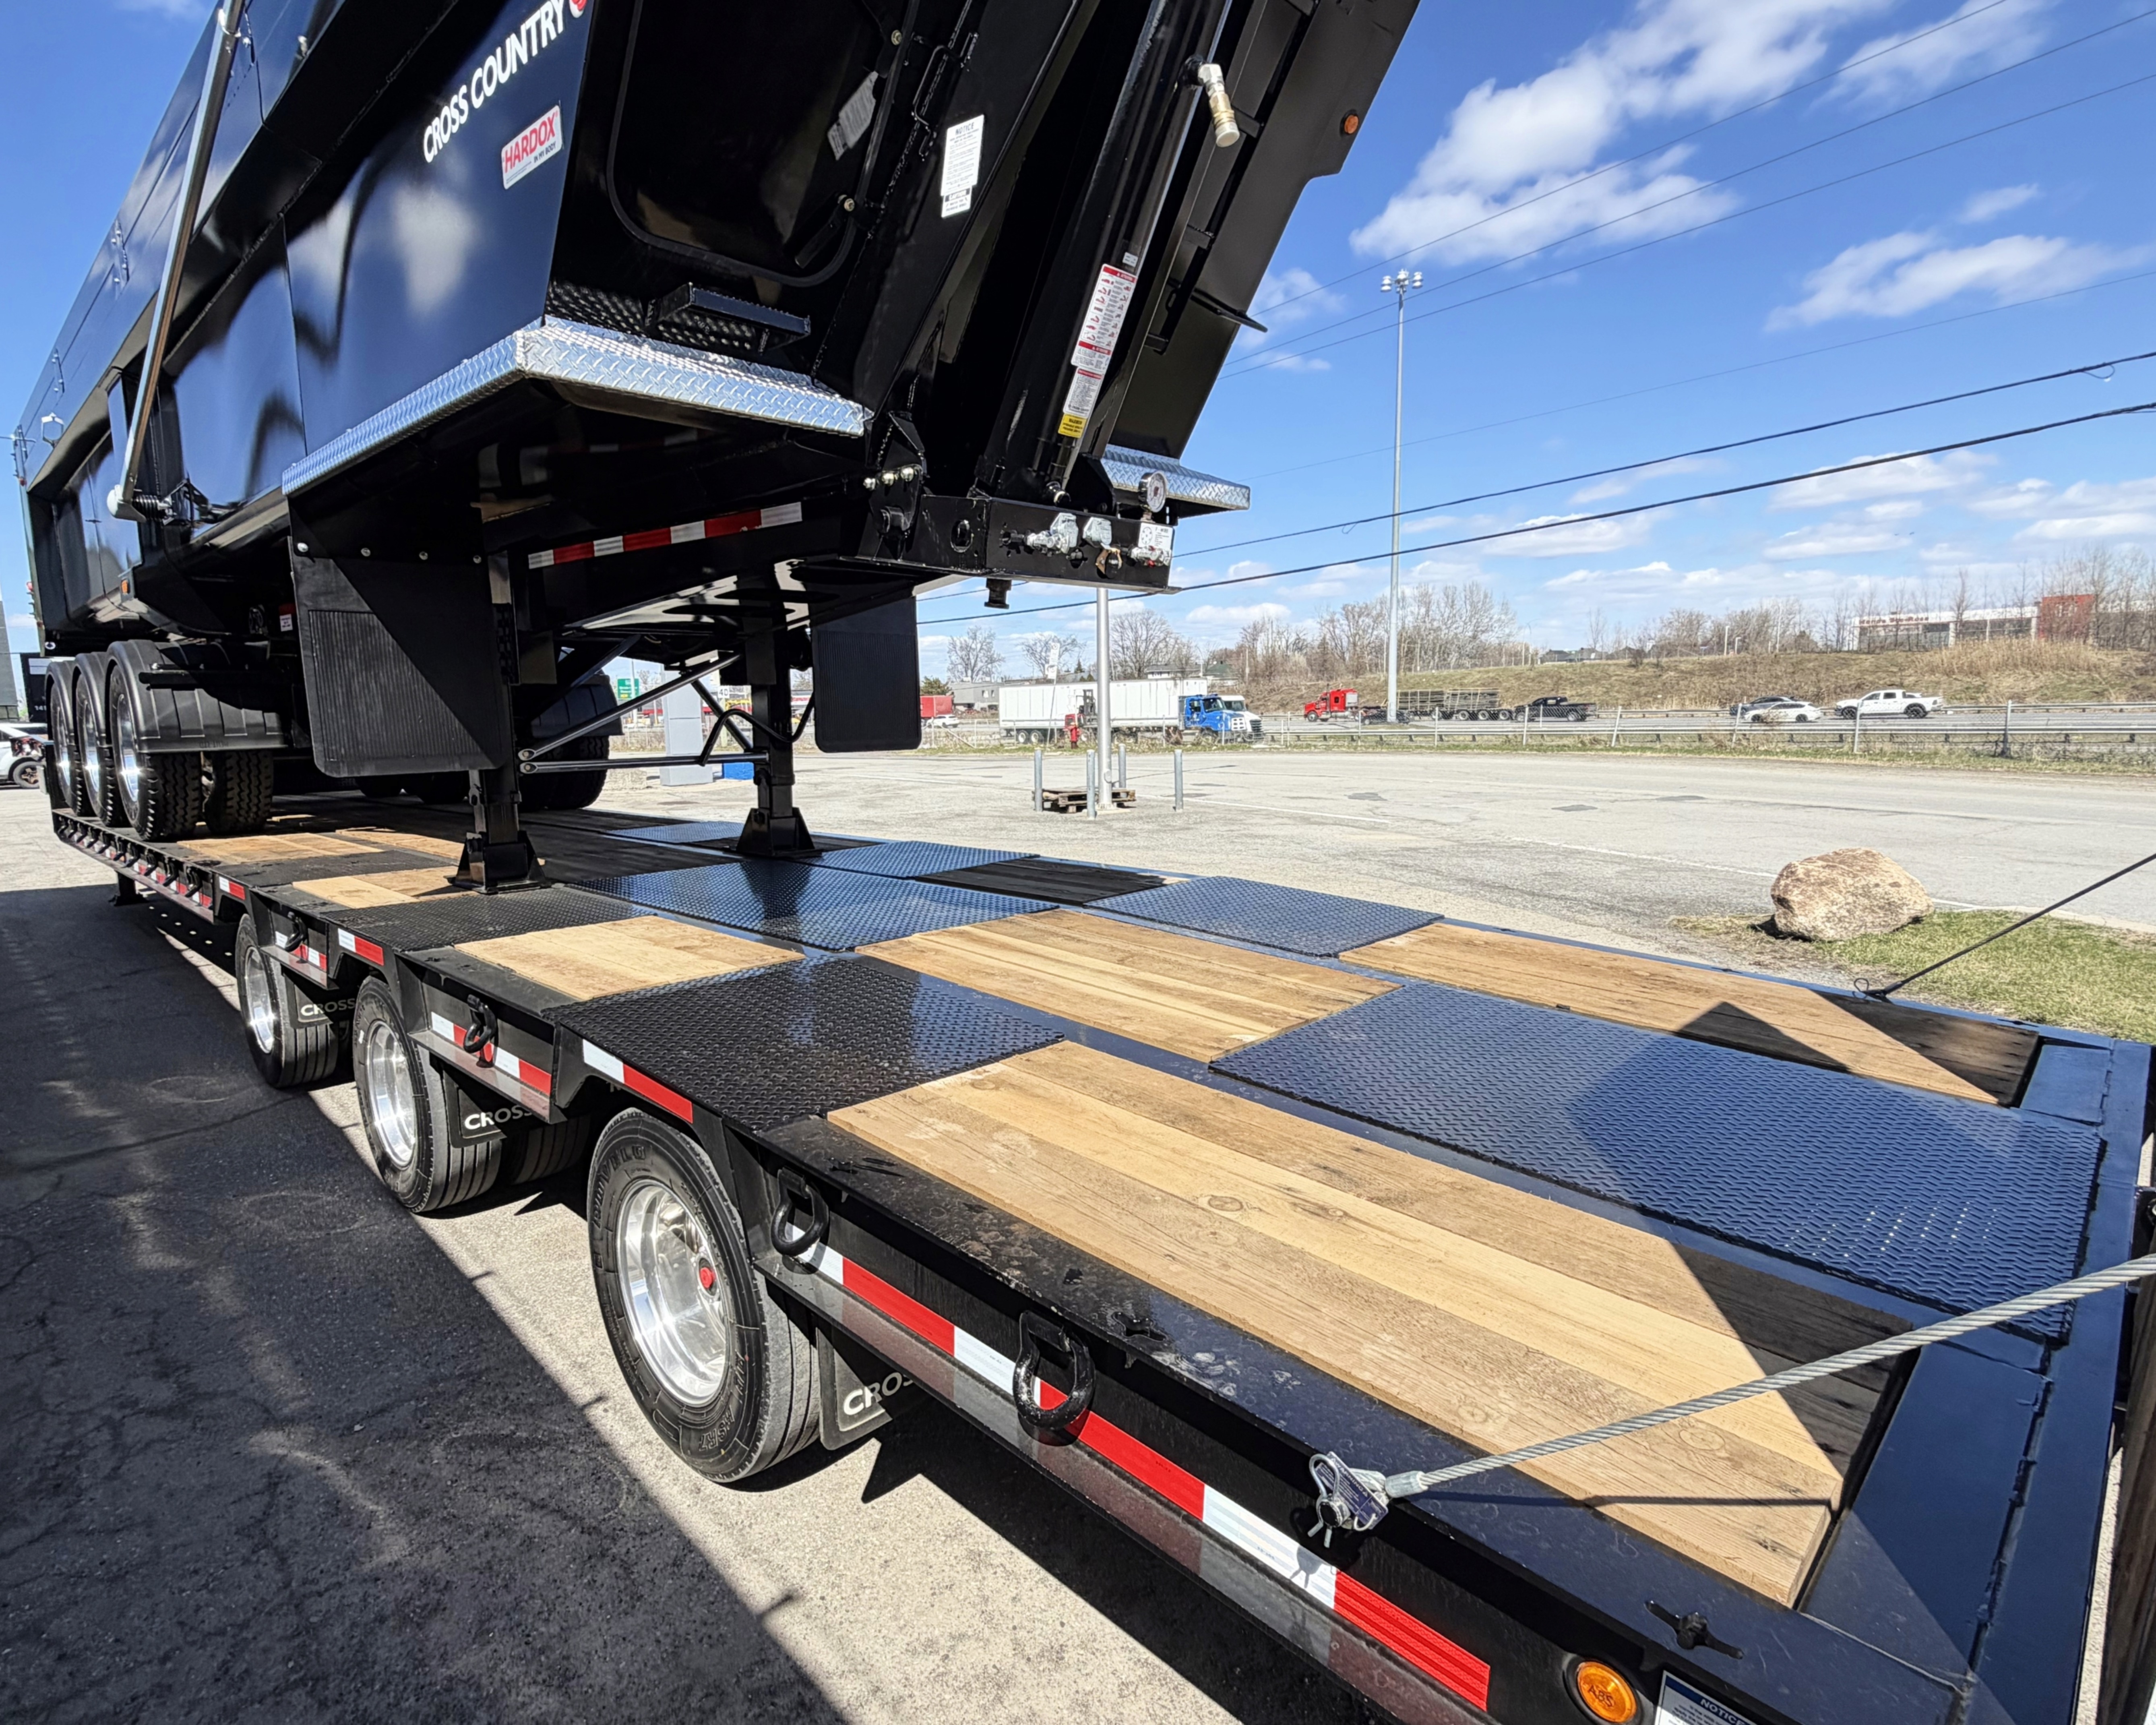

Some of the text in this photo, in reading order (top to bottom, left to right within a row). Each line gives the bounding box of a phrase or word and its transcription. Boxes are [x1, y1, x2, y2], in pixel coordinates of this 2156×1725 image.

[424, 0, 563, 163] CROSS COUNTRY
[505, 112, 556, 173] HARDOX
[300, 998, 356, 1016] CROSS
[1588, 1685, 1615, 1708] ABS
